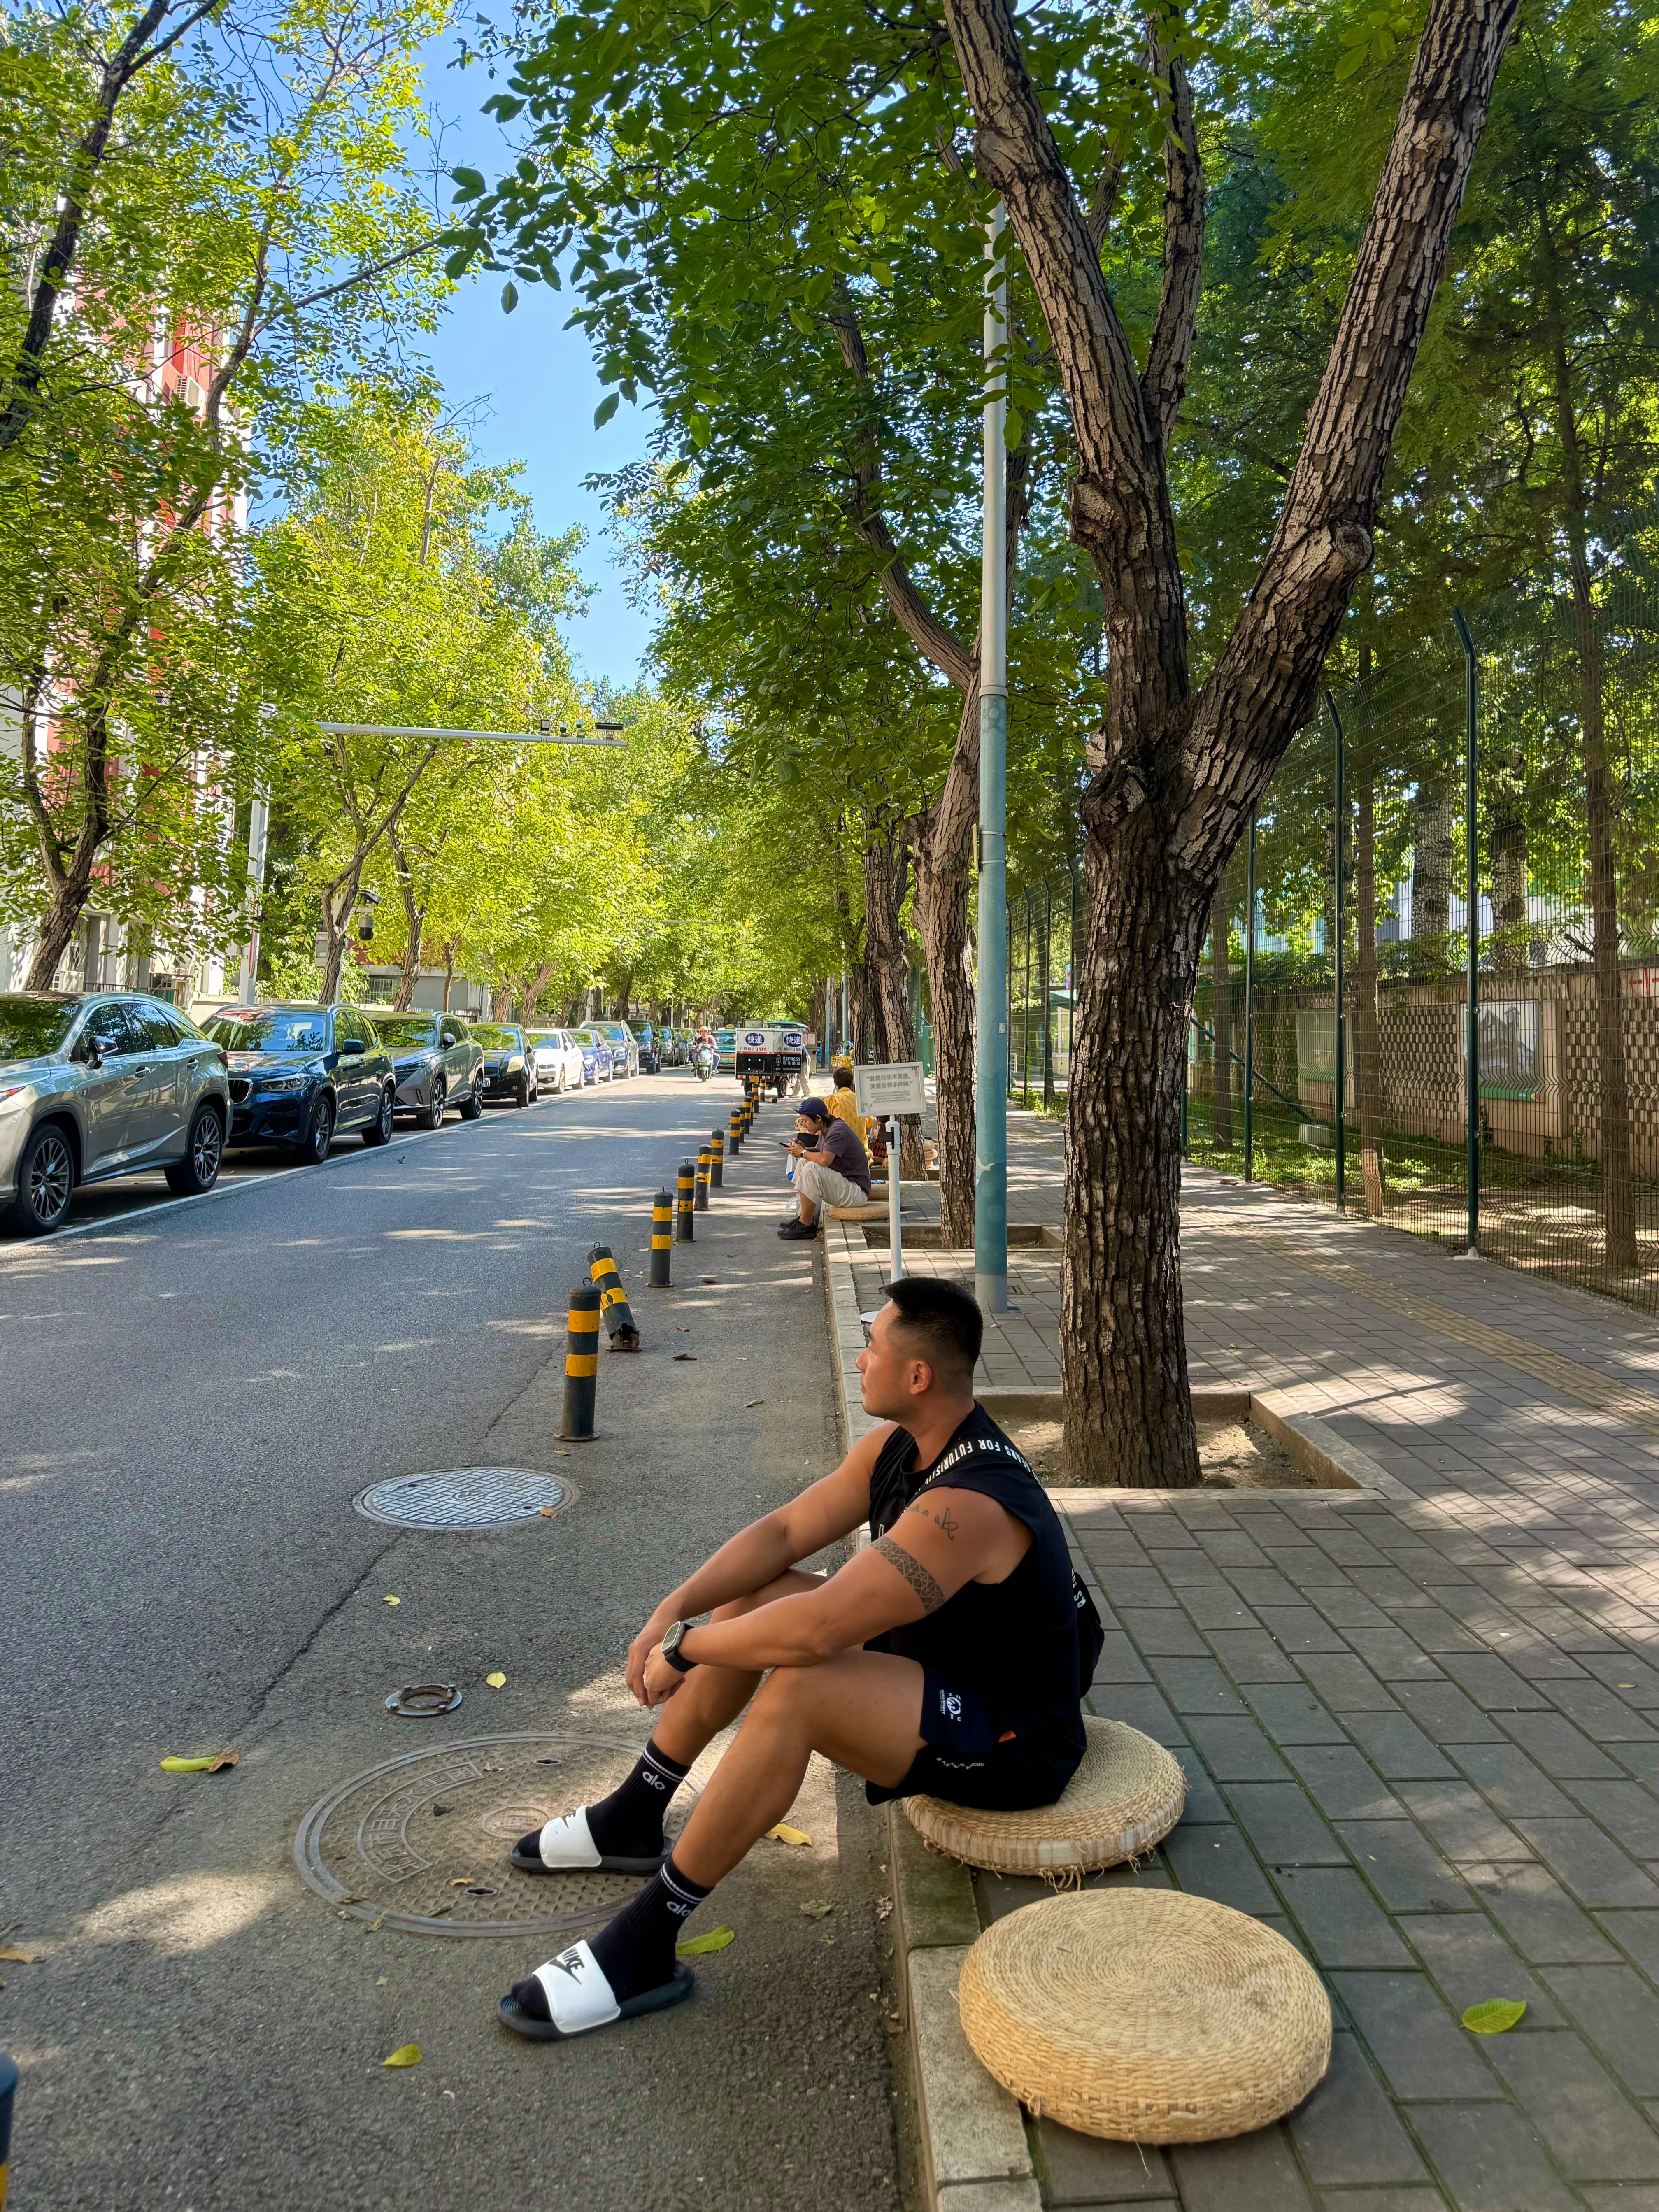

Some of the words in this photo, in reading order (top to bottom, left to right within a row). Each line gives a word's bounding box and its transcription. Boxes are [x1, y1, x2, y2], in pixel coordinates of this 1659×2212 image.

[747, 1035, 762, 1044] 快递
[786, 1035, 801, 1044] 快递
[977, 1439, 1001, 1452] FOR
[642, 1771, 665, 1790] alo
[666, 1900, 691, 1917] alo
[561, 1947, 585, 1970] NIKE
